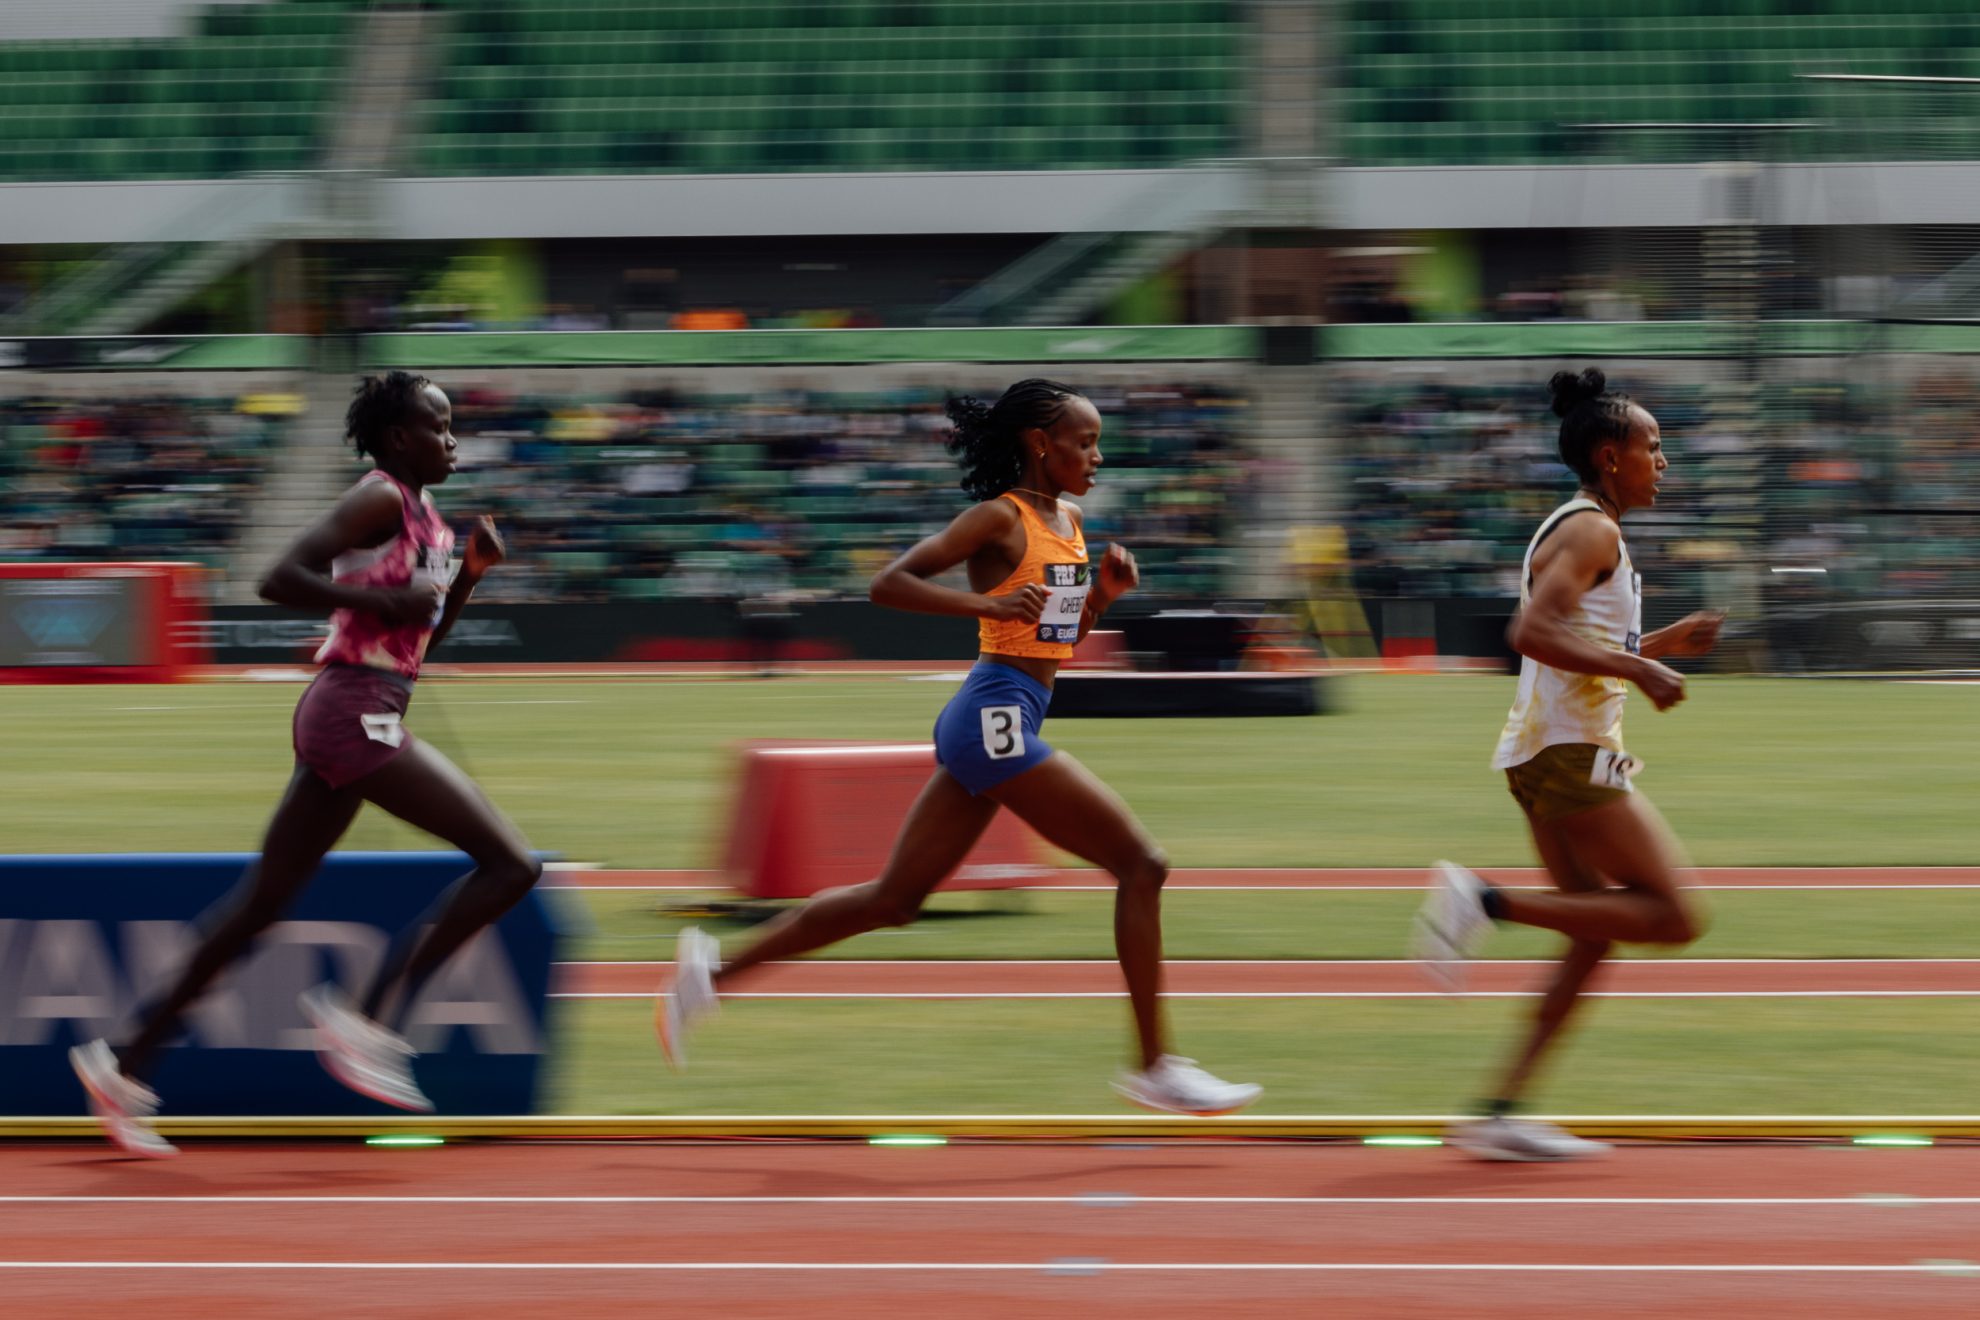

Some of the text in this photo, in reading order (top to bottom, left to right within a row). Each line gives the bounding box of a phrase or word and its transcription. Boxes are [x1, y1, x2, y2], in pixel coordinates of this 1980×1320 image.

[1053, 564, 1076, 586] PRE
[991, 711, 1015, 756] 3
[0, 918, 546, 1055] ANDA
